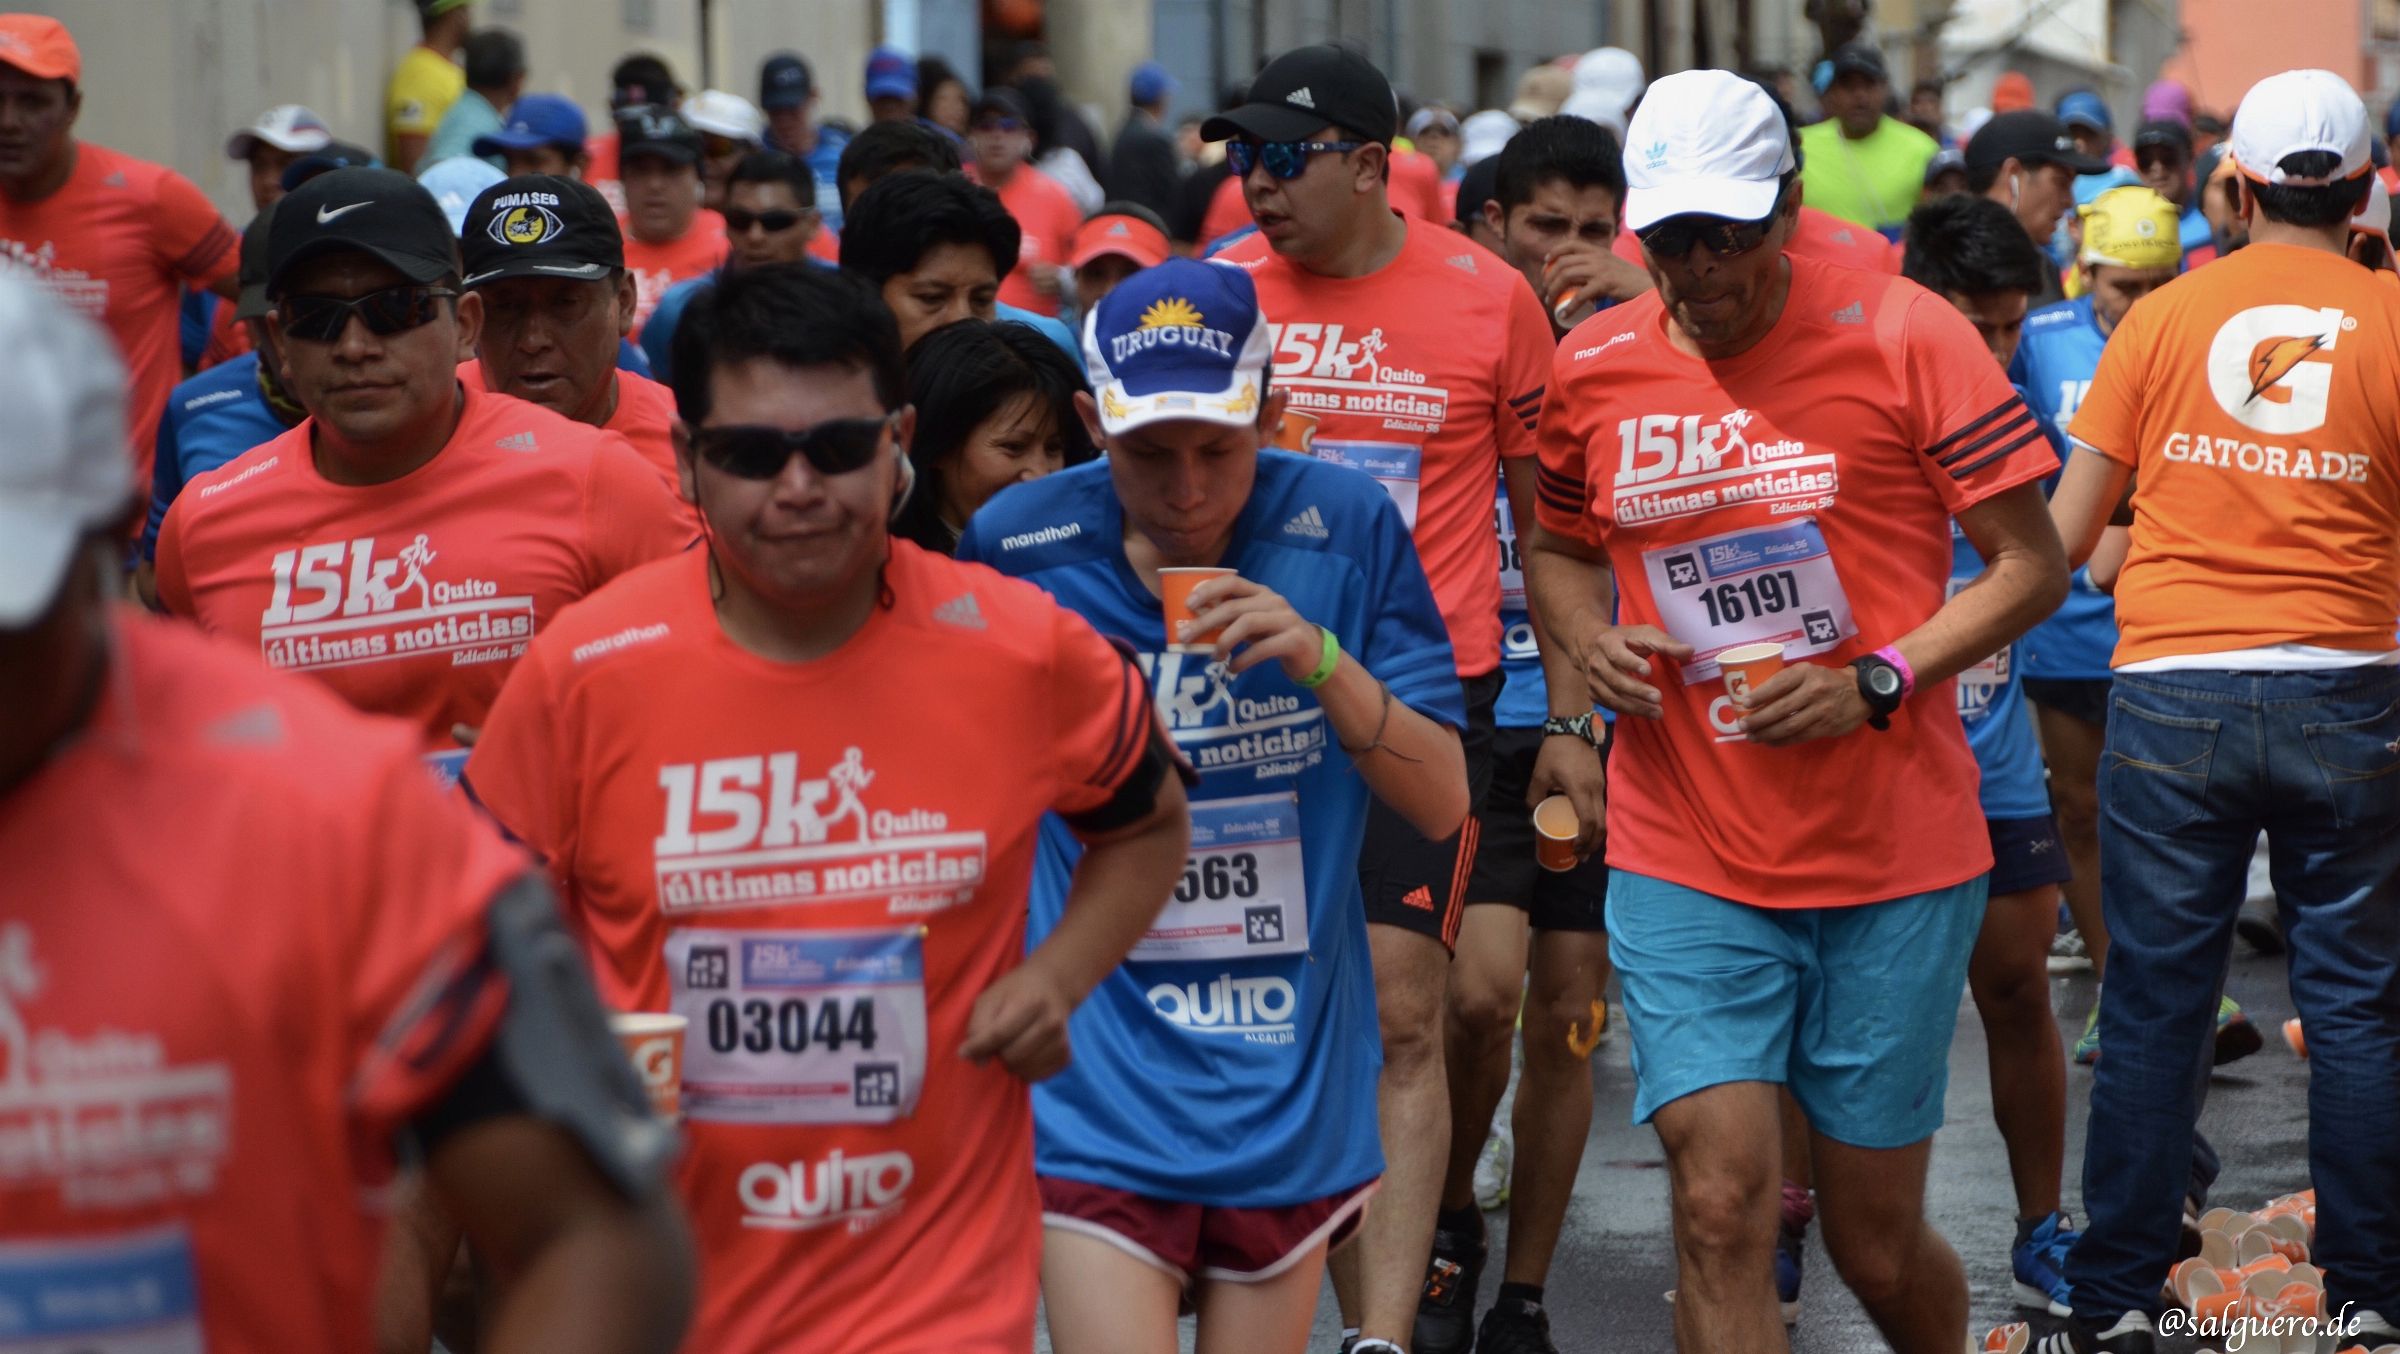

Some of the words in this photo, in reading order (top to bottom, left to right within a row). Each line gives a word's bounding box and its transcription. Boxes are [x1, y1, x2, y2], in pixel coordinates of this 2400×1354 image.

[492, 192, 560, 210] PUMASEG
[1111, 325, 1234, 363] URUGUAY
[1380, 366, 1426, 384] Quito
[1345, 391, 1443, 418] noticias
[1614, 414, 1722, 487] 15k
[1752, 441, 1804, 463] Quito
[2163, 432, 2370, 483] GATORADE
[201, 456, 279, 498] marathon
[1618, 487, 1717, 523] últimas
[1722, 470, 1834, 502] noticias
[1769, 500, 1816, 516] Edición
[1818, 496, 1835, 508] 56
[1001, 522, 1082, 551] marathon
[262, 539, 397, 627] 15k
[433, 579, 497, 603] Quito
[1698, 570, 1800, 628] 16197
[268, 633, 388, 669] últimas
[395, 612, 530, 652] noticias
[453, 646, 508, 667] Edición
[573, 623, 669, 663] marathon
[1239, 695, 1299, 720] Quito
[1200, 727, 1322, 766] noticias
[655, 752, 830, 856] 15k
[872, 809, 948, 838] Quito
[664, 868, 816, 908] últimas
[823, 850, 980, 892] noticias
[1175, 853, 1260, 903] 563
[708, 997, 877, 1054] 03044
